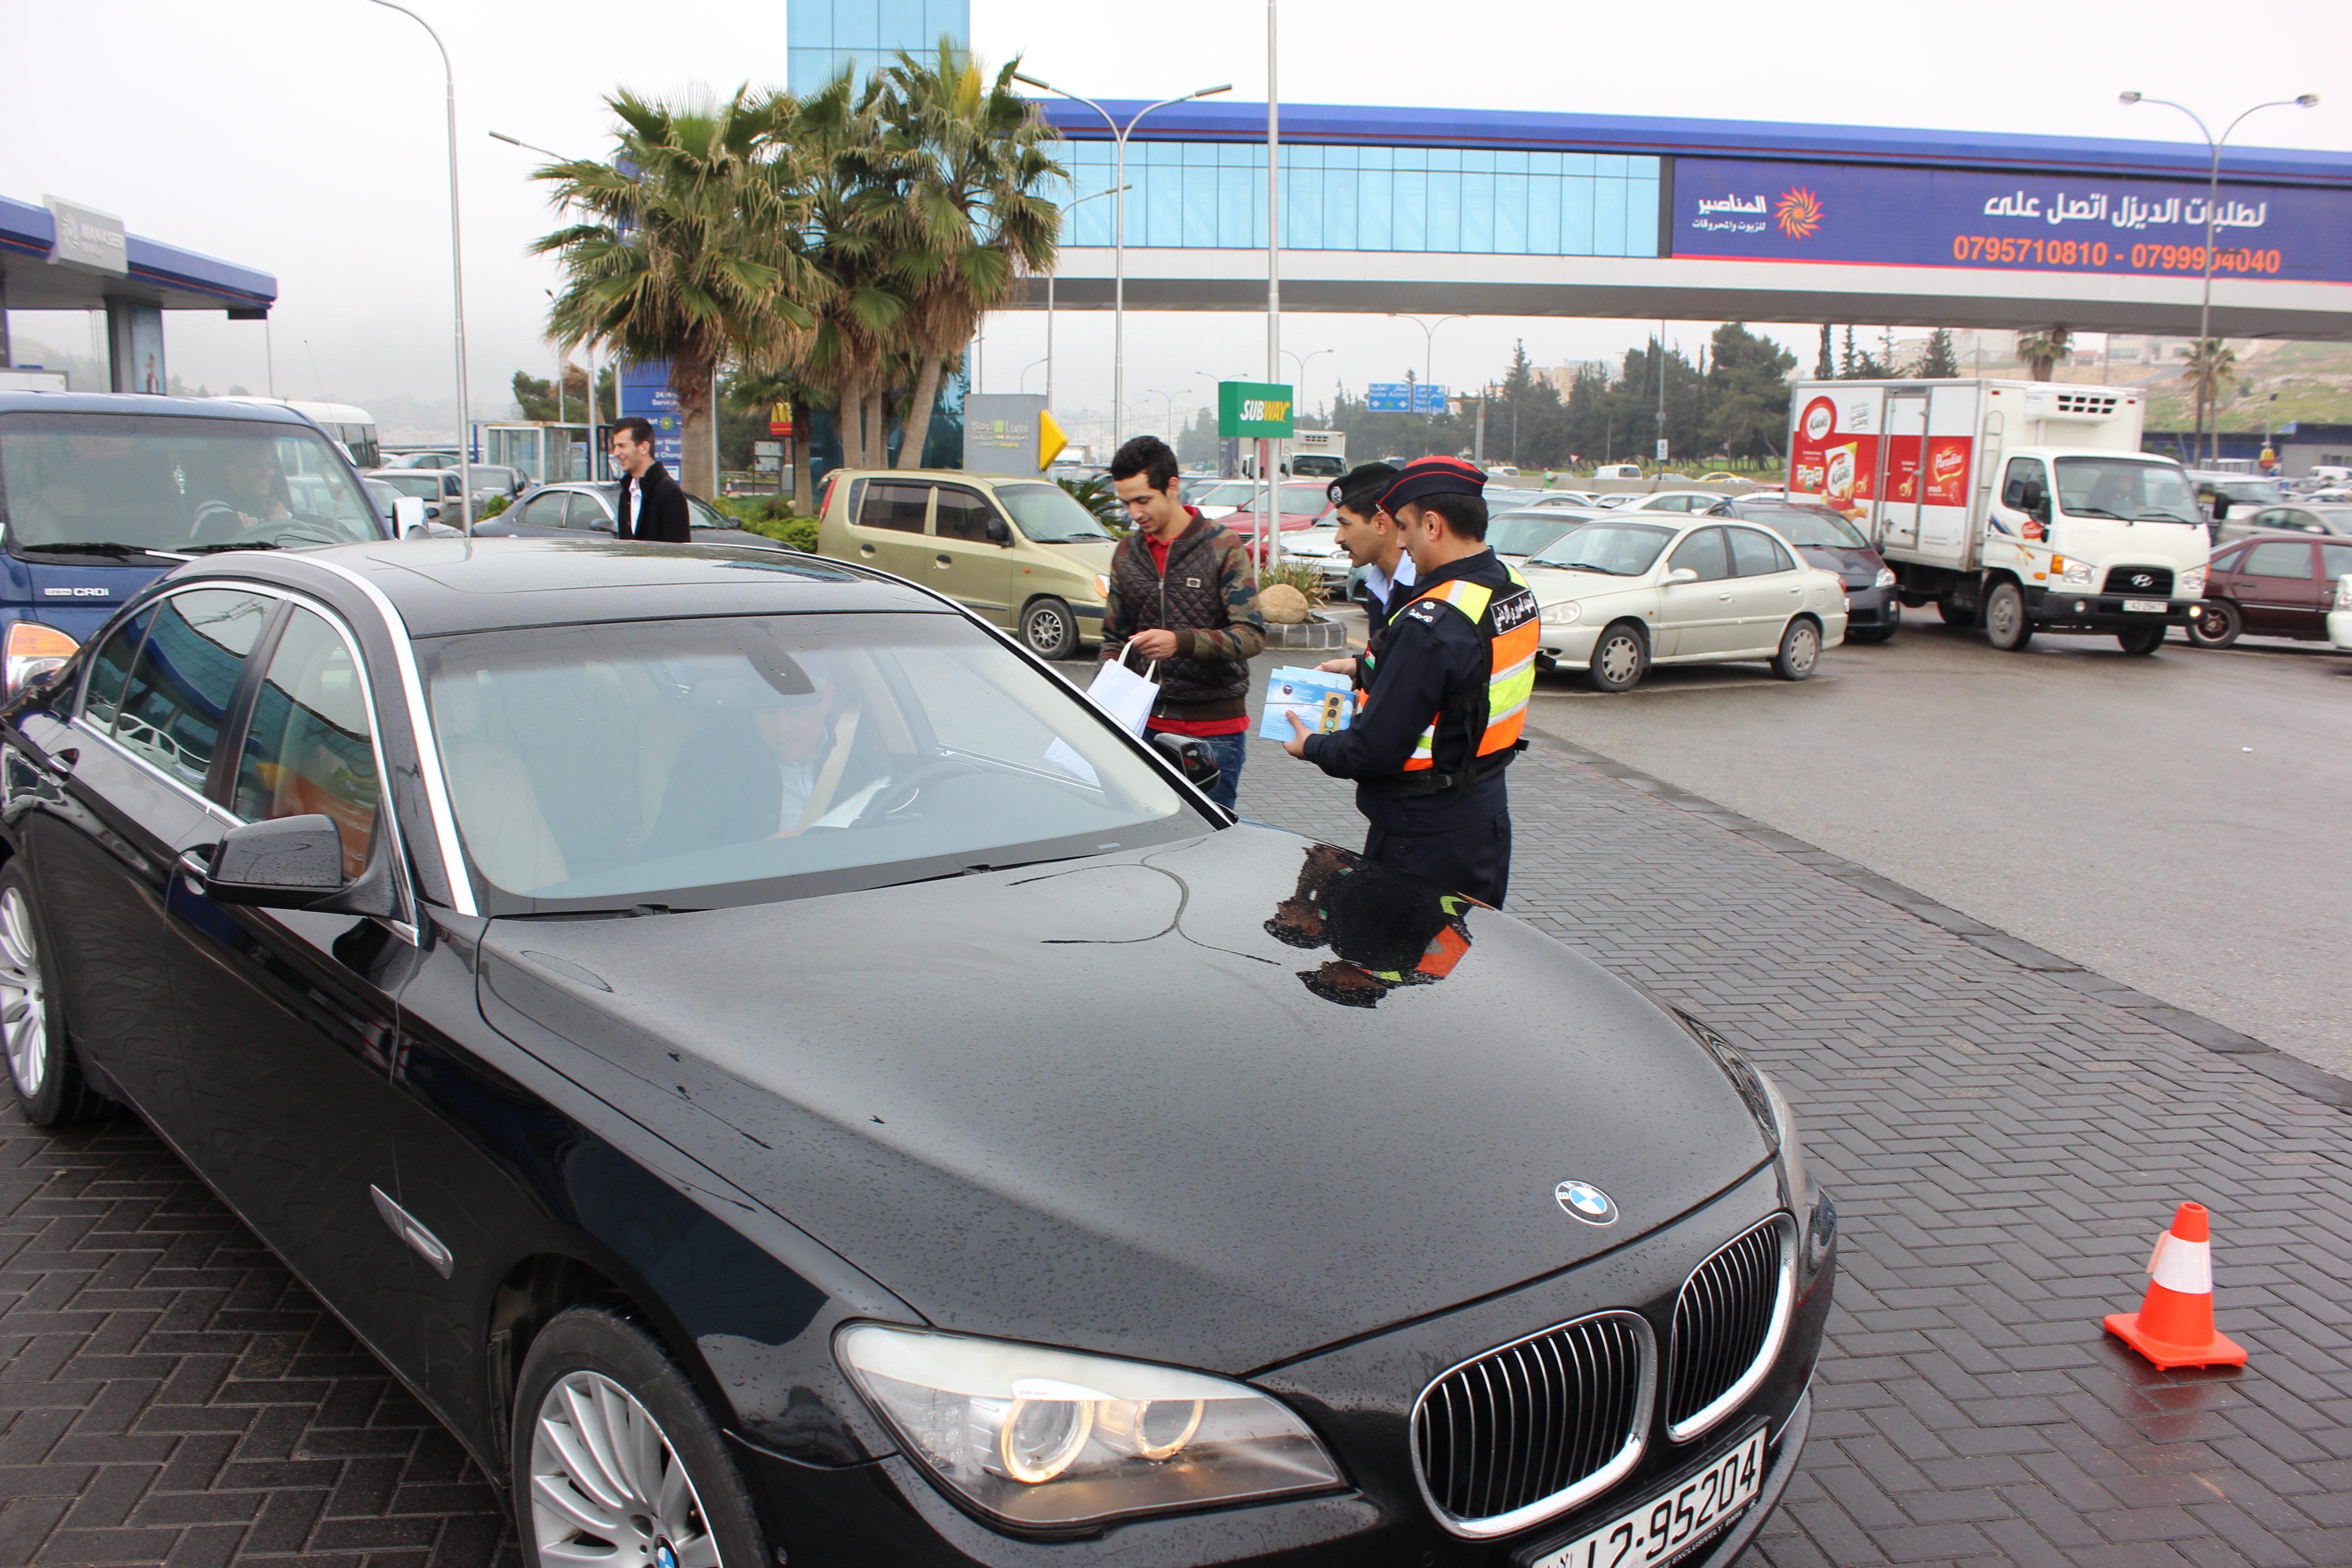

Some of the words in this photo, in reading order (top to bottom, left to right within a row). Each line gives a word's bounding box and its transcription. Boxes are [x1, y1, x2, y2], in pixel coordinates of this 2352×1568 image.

[1698, 193, 1767, 215] المناصير
[1984, 191, 2040, 217] على
[2046, 192, 2108, 225] اتصل
[2111, 196, 2180, 230] الديزل
[2184, 198, 2267, 232] لطلبات
[1738, 221, 1766, 233] للزيوت
[1953, 235, 2108, 266] 0795710810
[1240, 399, 1291, 421] SUBWAY
[74, 588, 109, 596] CRDi
[1672, 1524, 1723, 1564] EXCLUSIVELY
[1725, 1509, 1743, 1526] BMW
